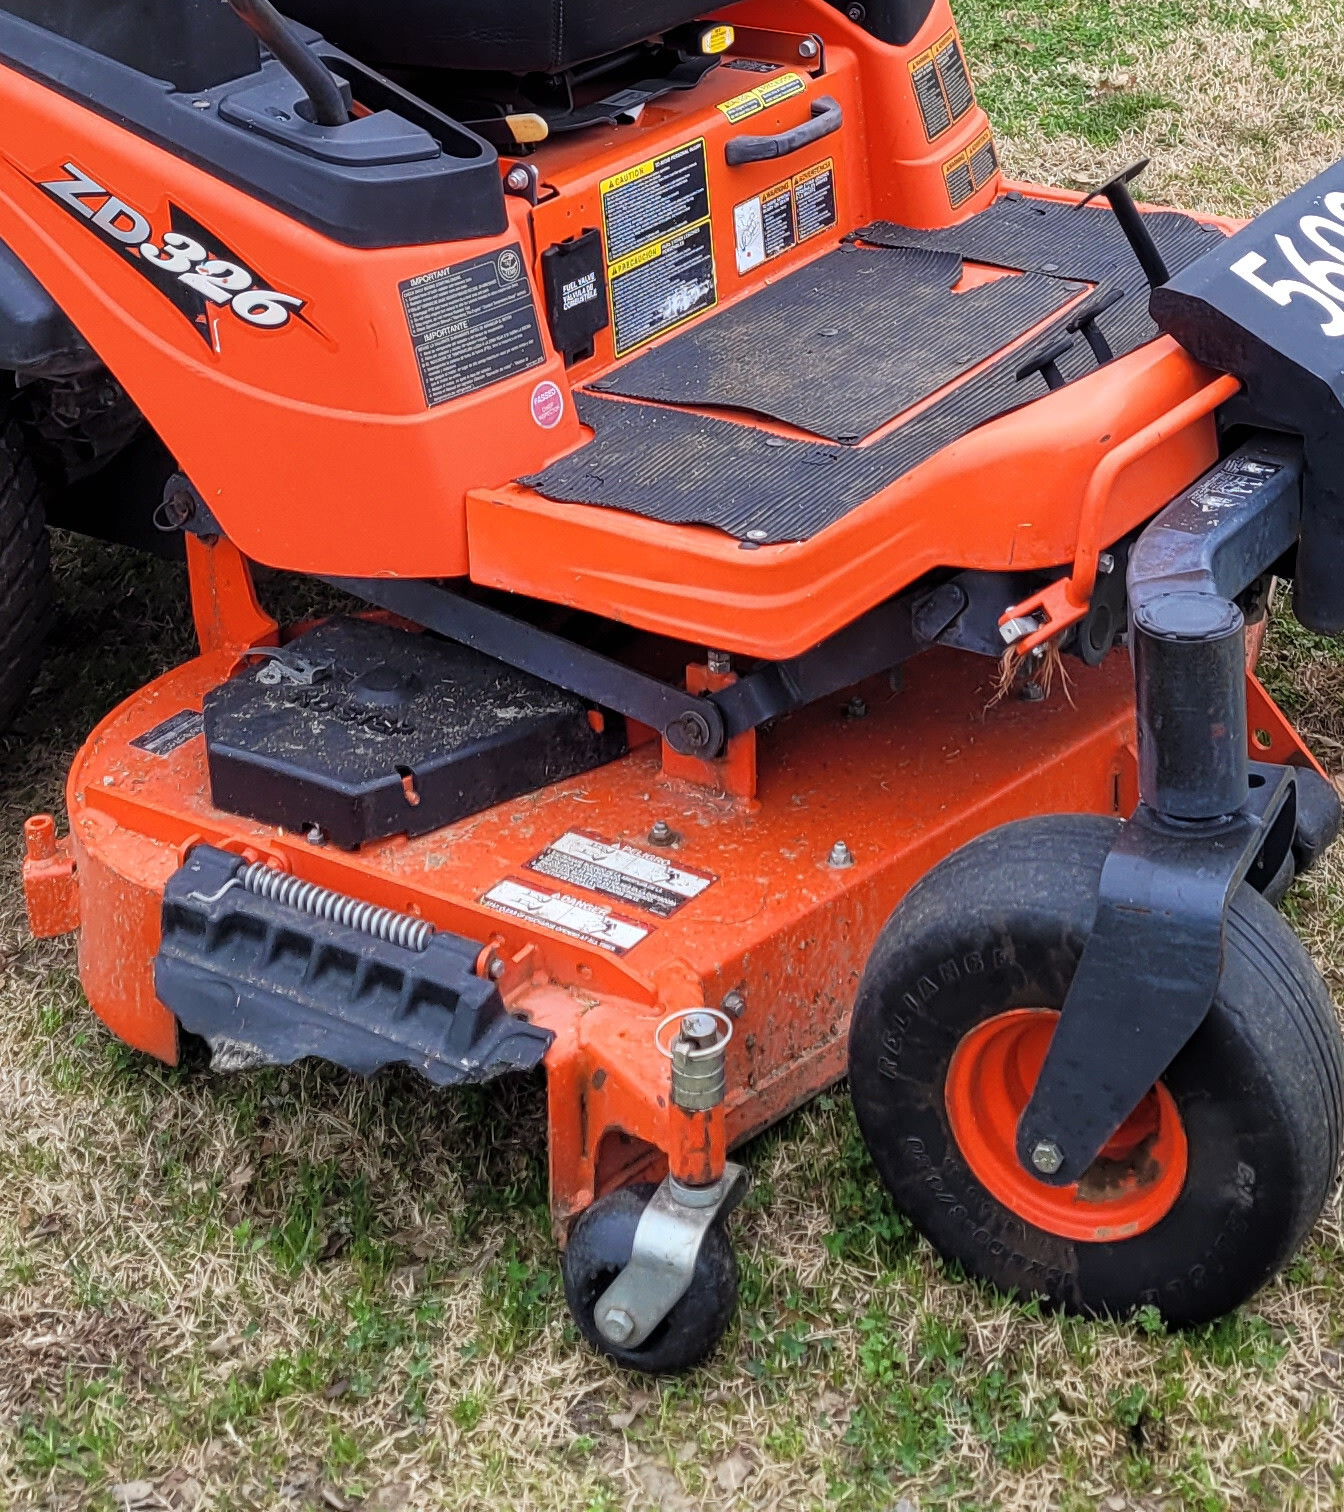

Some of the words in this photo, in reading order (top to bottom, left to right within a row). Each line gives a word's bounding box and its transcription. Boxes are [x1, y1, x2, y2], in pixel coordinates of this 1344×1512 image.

[614, 168, 644, 186] CAUTION
[39, 161, 305, 326] ZD326
[409, 267, 451, 287] IMPORTANT
[562, 281, 578, 293] FUEL
[577, 271, 595, 286] VALVE
[423, 320, 470, 342] IMPORTANTE
[533, 387, 556, 406] PASSED
[622, 844, 671, 866] PELIGRO
[560, 895, 608, 917] DANGER
